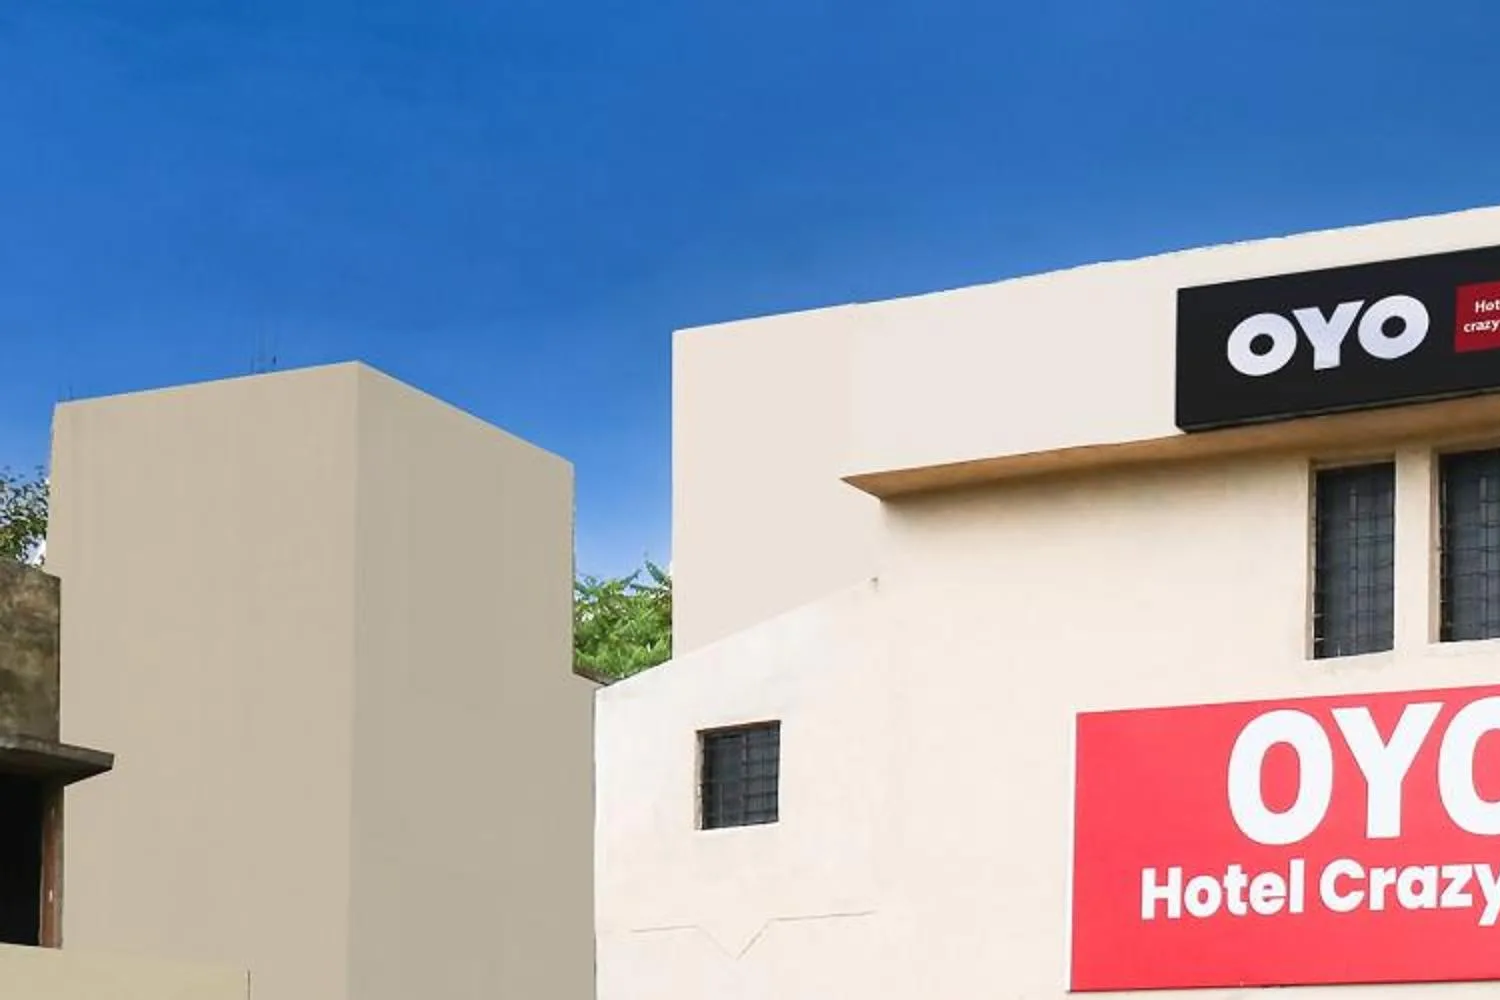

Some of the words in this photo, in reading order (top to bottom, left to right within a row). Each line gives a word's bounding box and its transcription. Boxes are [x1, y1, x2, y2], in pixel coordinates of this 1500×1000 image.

[1226, 294, 1430, 377] OYO
[1463, 319, 1500, 333] crazy
[1141, 859, 1305, 919] Hotel
